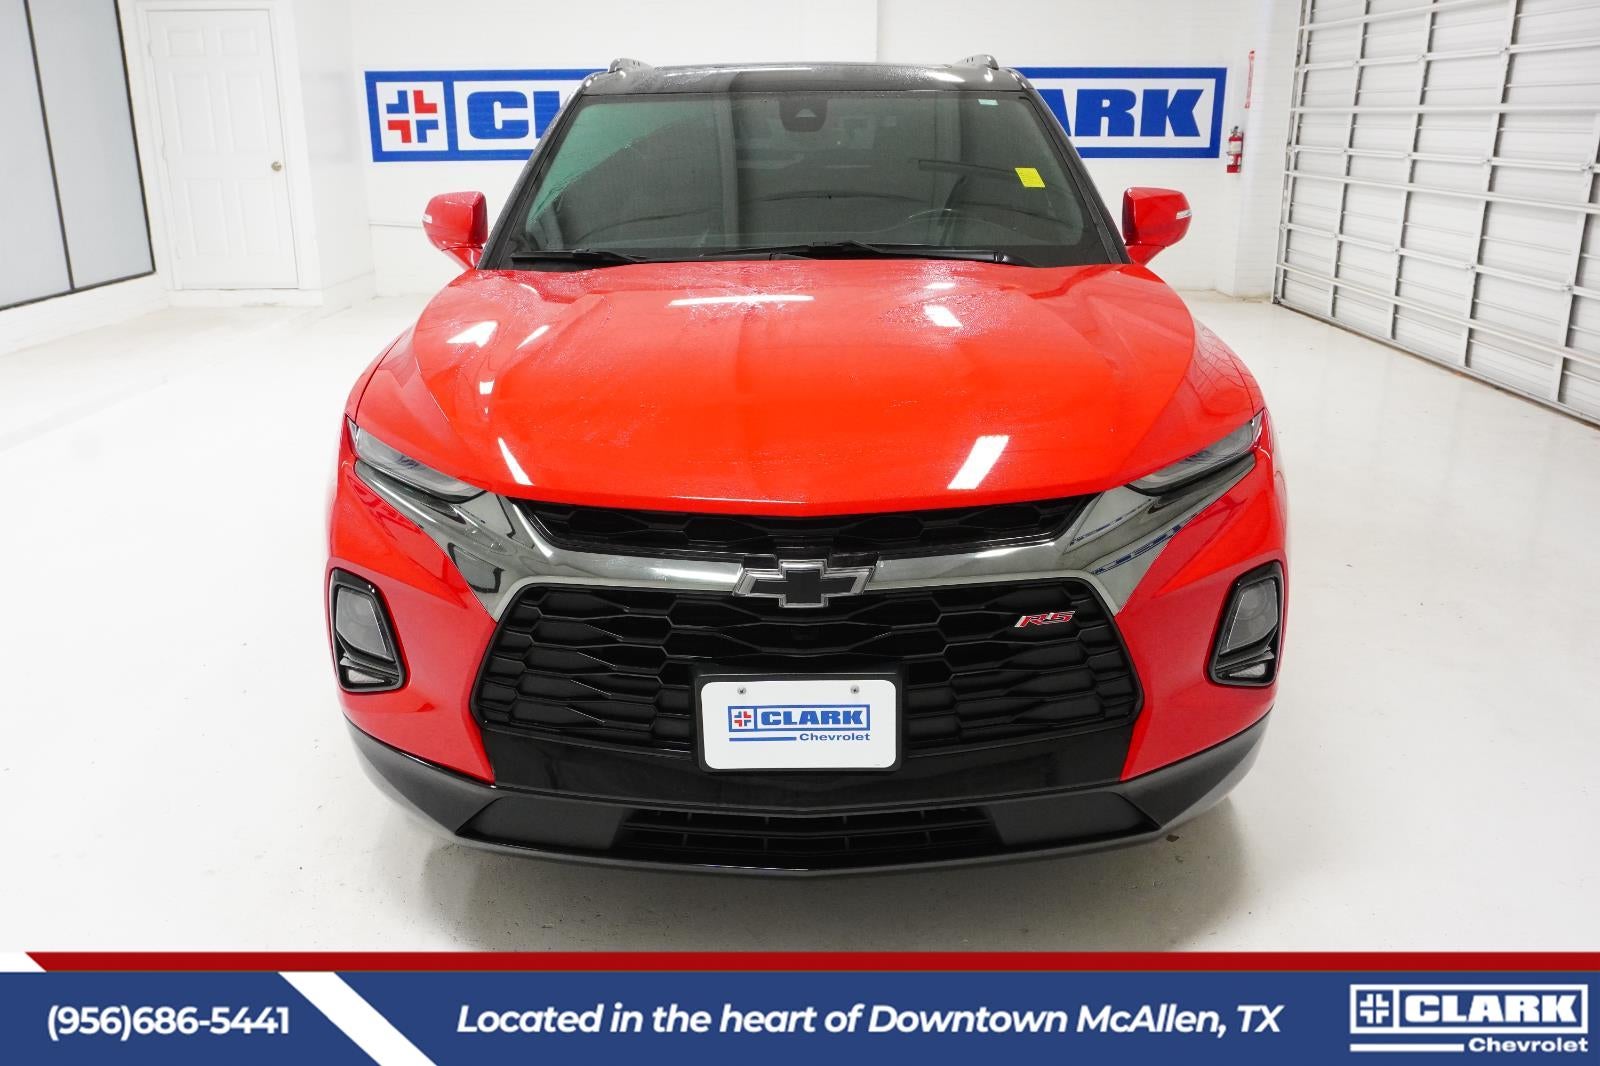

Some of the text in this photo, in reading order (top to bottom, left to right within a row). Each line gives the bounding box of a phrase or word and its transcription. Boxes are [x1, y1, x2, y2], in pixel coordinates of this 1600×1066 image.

[1014, 611, 1075, 628] RS
[761, 710, 863, 726] CLARK
[800, 733, 870, 741] Chevrolet
